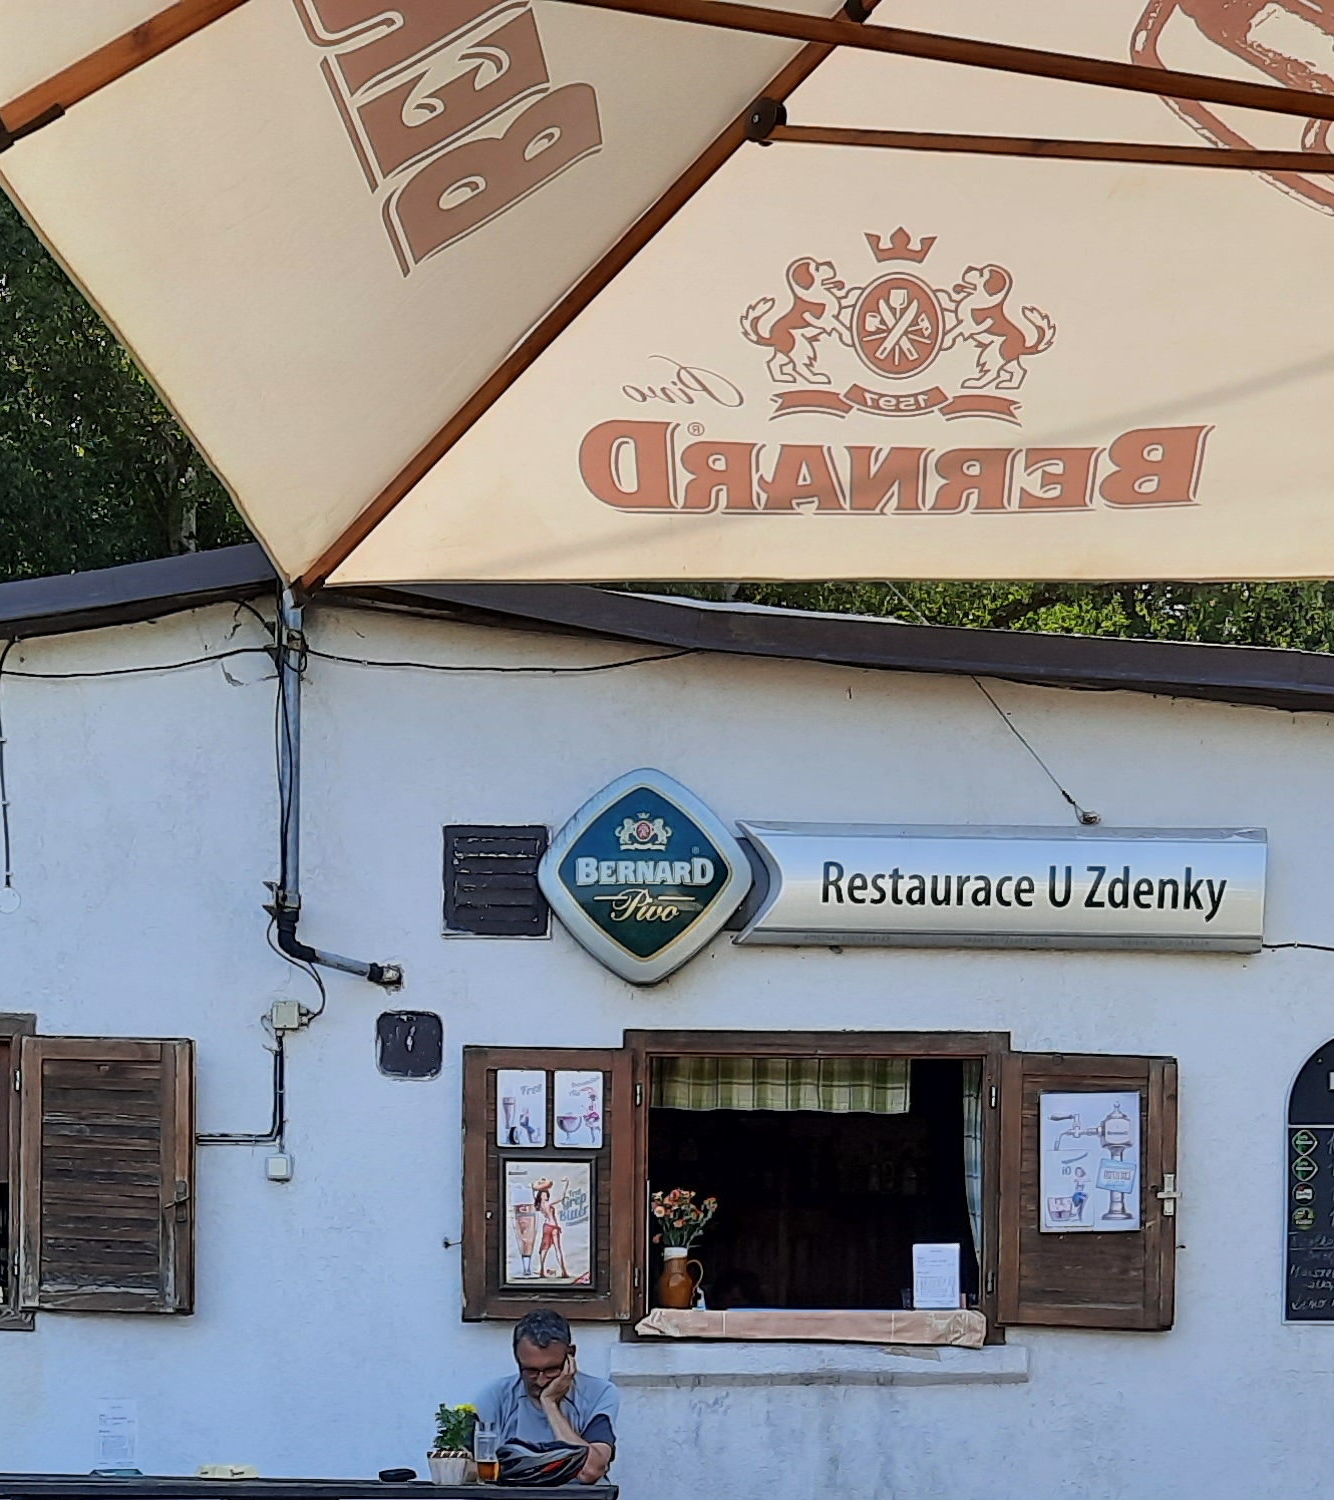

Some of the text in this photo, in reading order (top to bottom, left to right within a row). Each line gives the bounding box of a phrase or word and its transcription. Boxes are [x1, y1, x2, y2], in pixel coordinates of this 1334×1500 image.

[574, 853, 715, 887] BERNARD
[609, 888, 681, 924] Pivo
[821, 860, 1229, 922] Restaurace U Zdenky
